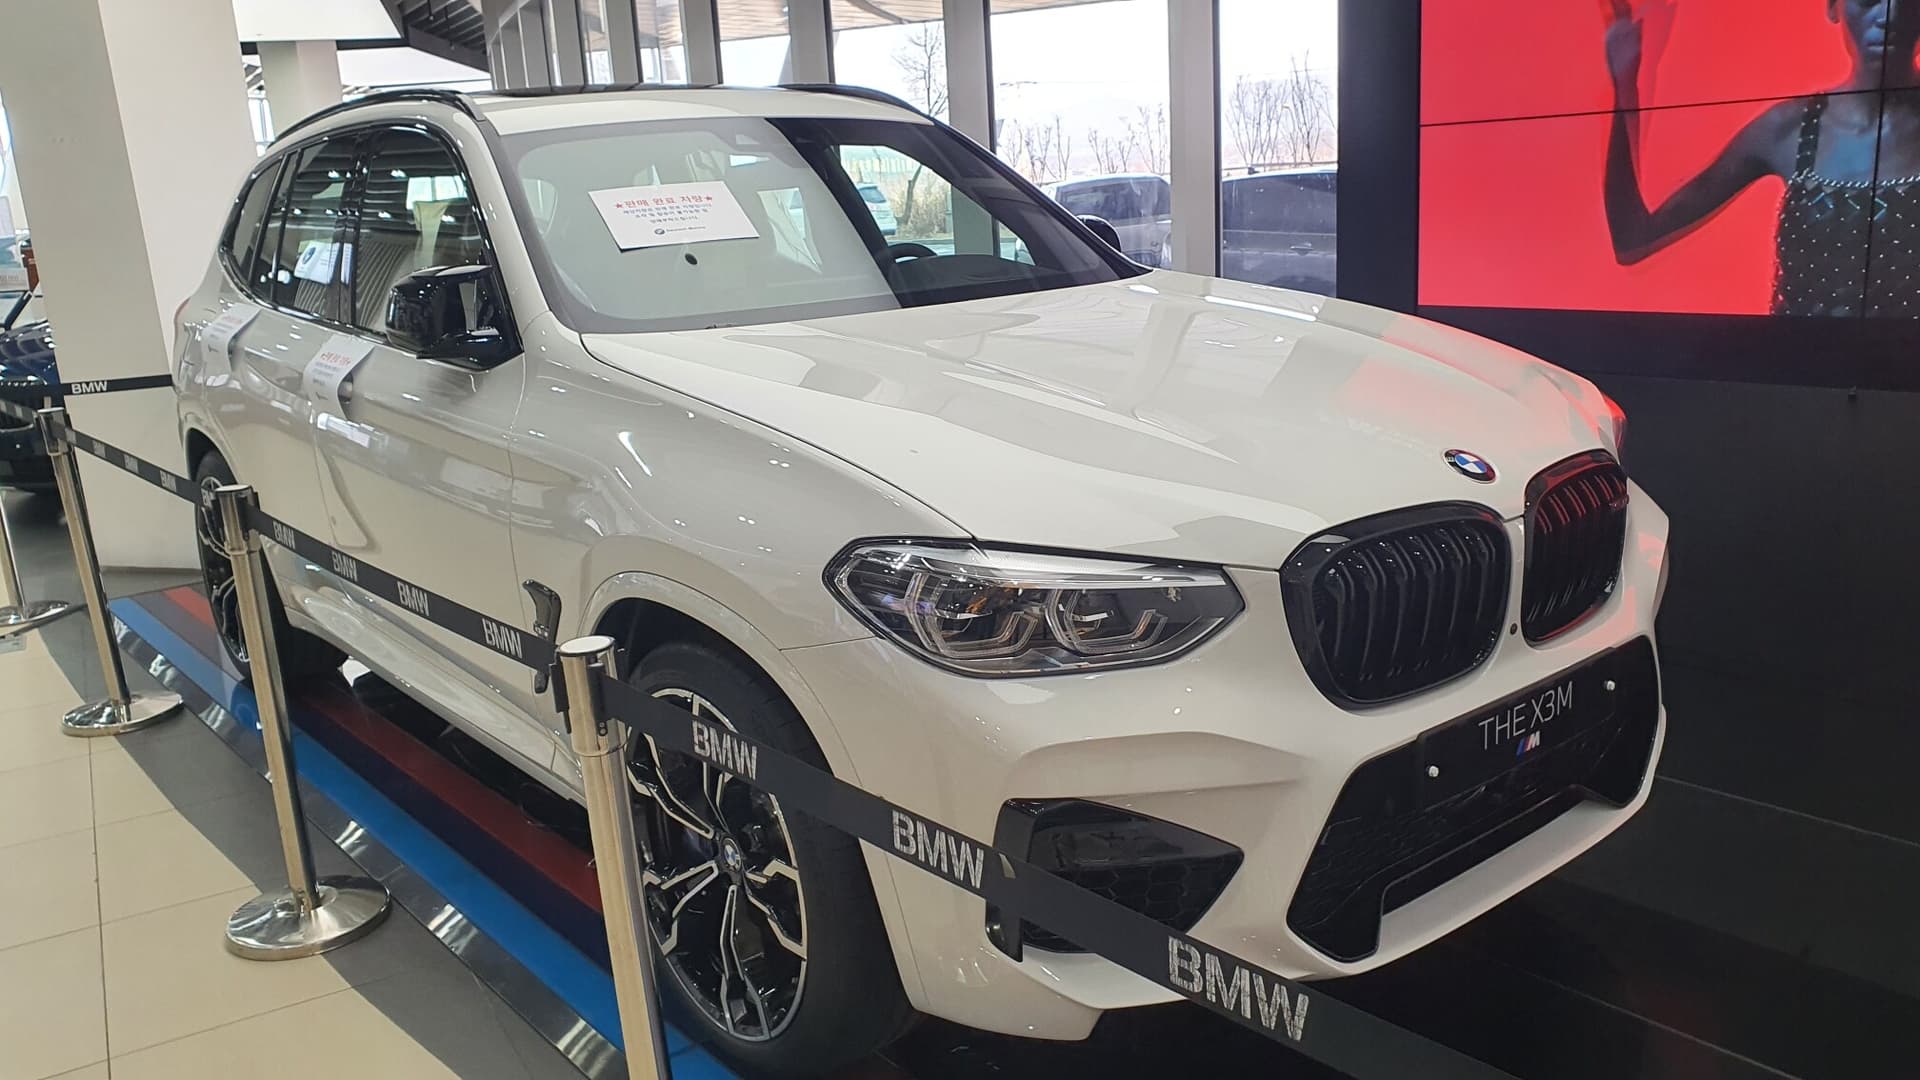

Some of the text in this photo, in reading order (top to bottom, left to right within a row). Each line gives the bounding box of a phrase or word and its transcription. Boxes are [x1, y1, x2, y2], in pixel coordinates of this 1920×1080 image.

[71, 381, 108, 394] BMW
[273, 520, 296, 549] BMW
[332, 551, 358, 582] BMW
[397, 581, 430, 617] BMW
[482, 618, 523, 659] BMW
[1478, 681, 1573, 751] THE X3M
[692, 720, 758, 781] BMW
[892, 810, 985, 889] BMW
[1168, 935, 1310, 1041] BMW
